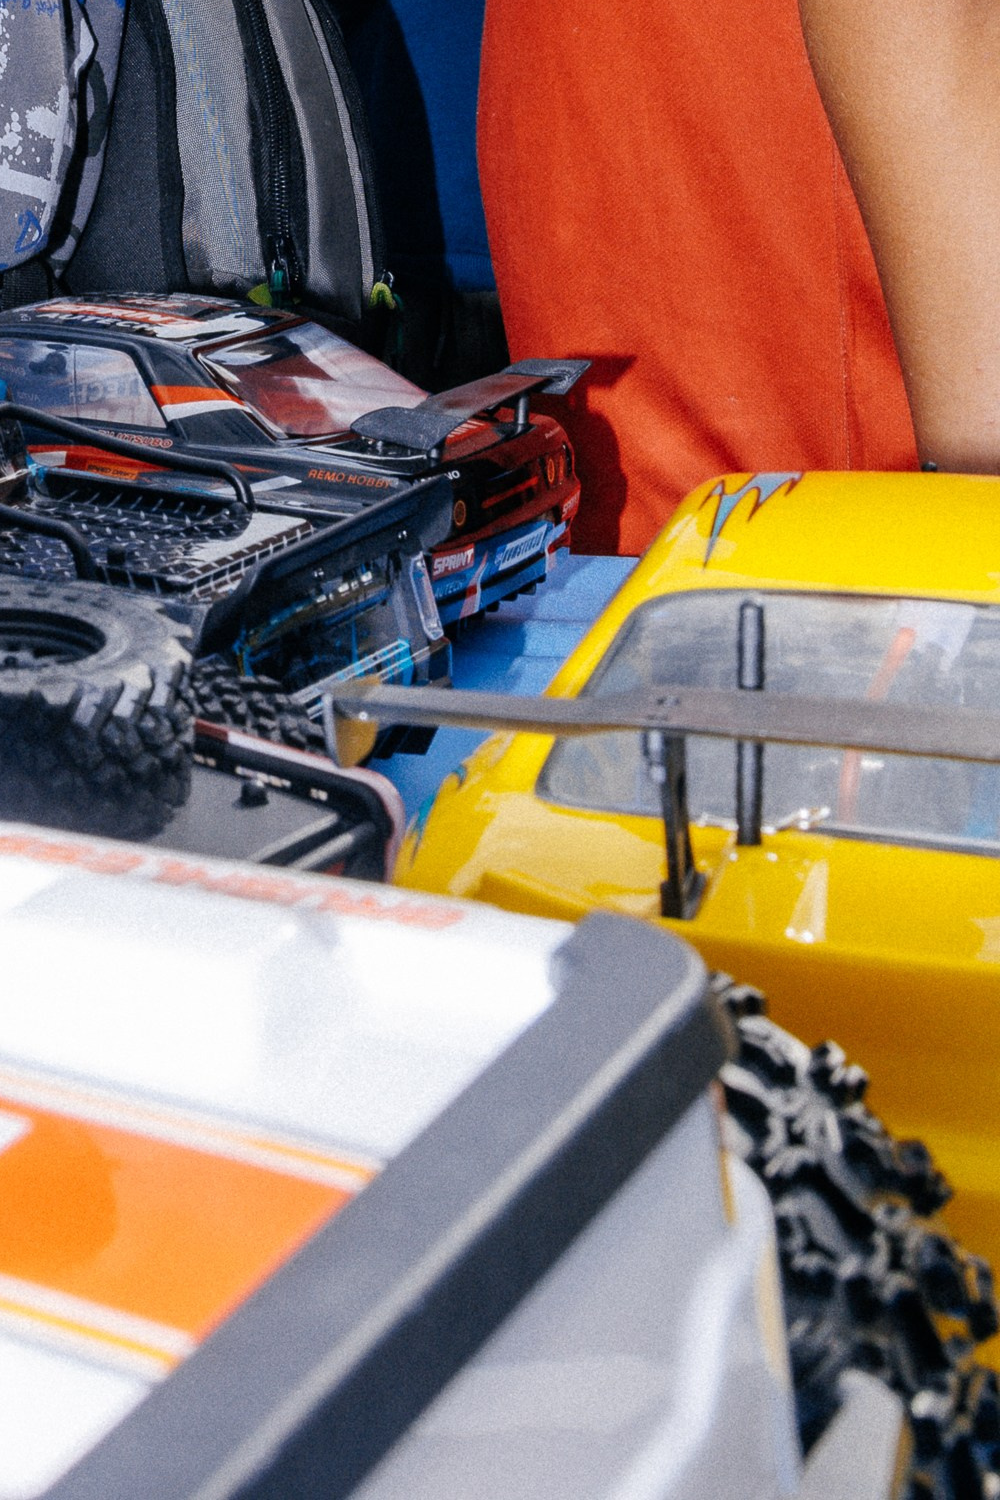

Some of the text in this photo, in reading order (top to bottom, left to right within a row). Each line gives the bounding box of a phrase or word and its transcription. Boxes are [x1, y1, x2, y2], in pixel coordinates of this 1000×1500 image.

[308, 468, 392, 490] REMO HOBBY
[433, 547, 475, 576] SPRINT
